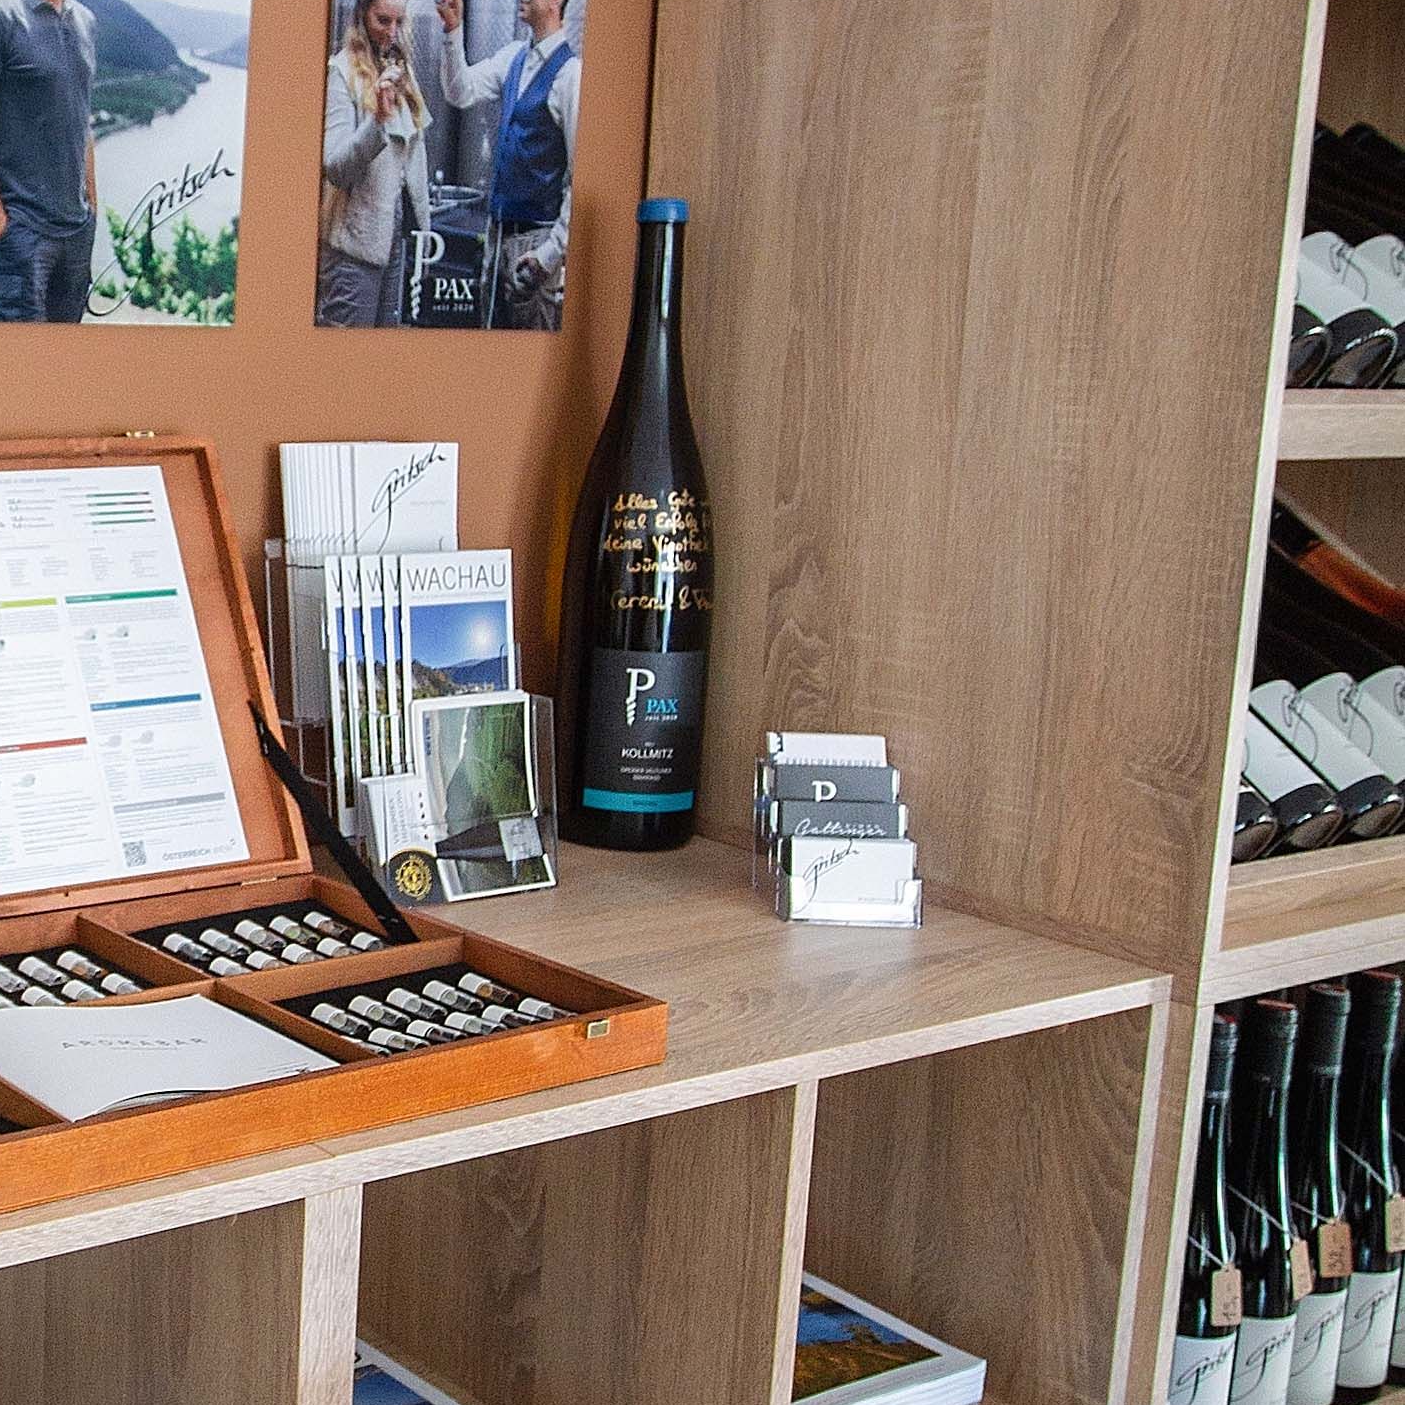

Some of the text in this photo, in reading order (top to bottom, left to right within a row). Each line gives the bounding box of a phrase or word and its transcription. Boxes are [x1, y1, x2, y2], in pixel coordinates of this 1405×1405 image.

[87, 148, 235, 316] Gritsch
[434, 278, 474, 299] PAX
[615, 494, 658, 511] Alles
[615, 512, 699, 534] viel Erfolg
[604, 535, 644, 552] deine
[406, 563, 507, 592] WACHAU
[646, 698, 679, 713] PAX
[621, 747, 674, 760] KOLLMITZ
[794, 817, 888, 839] Gattinger
